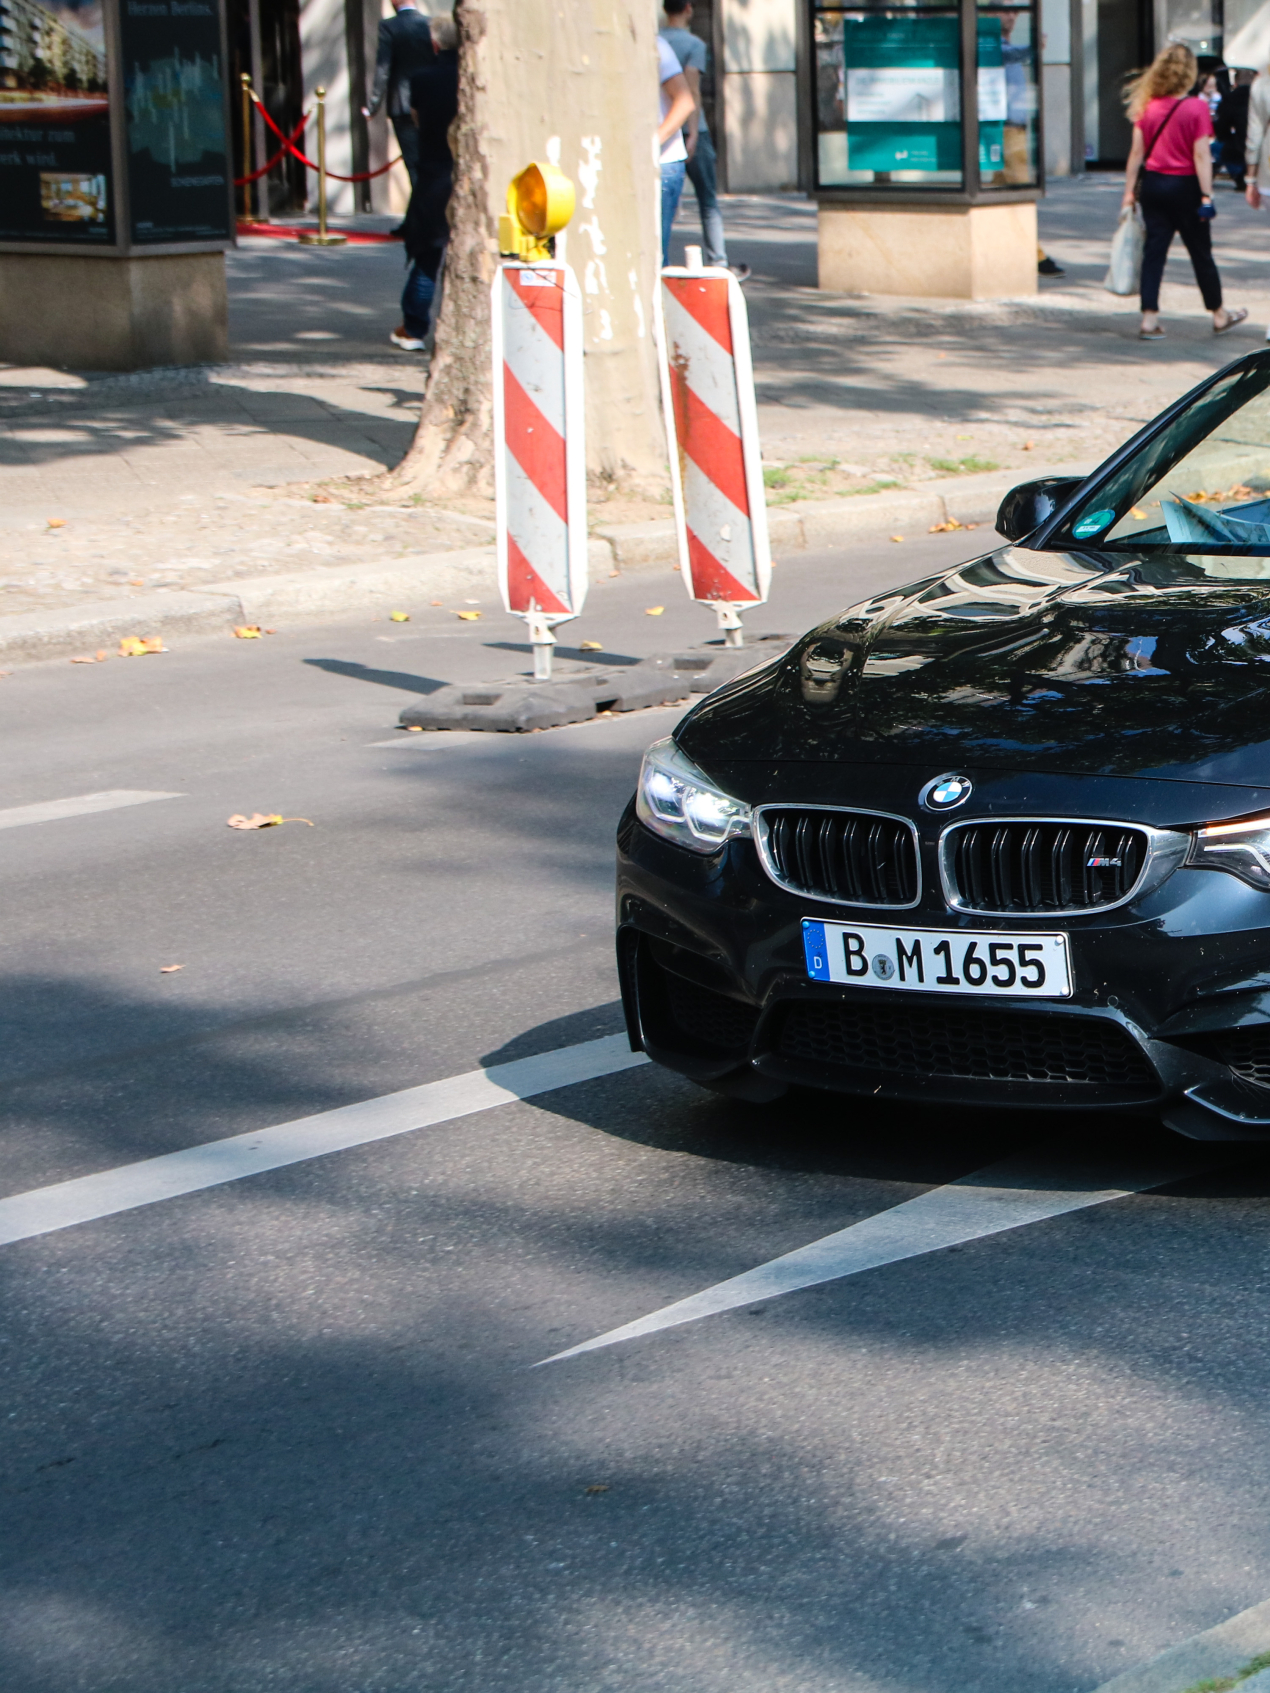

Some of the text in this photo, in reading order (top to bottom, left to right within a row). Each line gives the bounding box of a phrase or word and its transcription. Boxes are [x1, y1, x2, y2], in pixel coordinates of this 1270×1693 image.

[1097, 857, 1122, 867] M4
[813, 956, 823, 970] D
[843, 931, 870, 977] B
